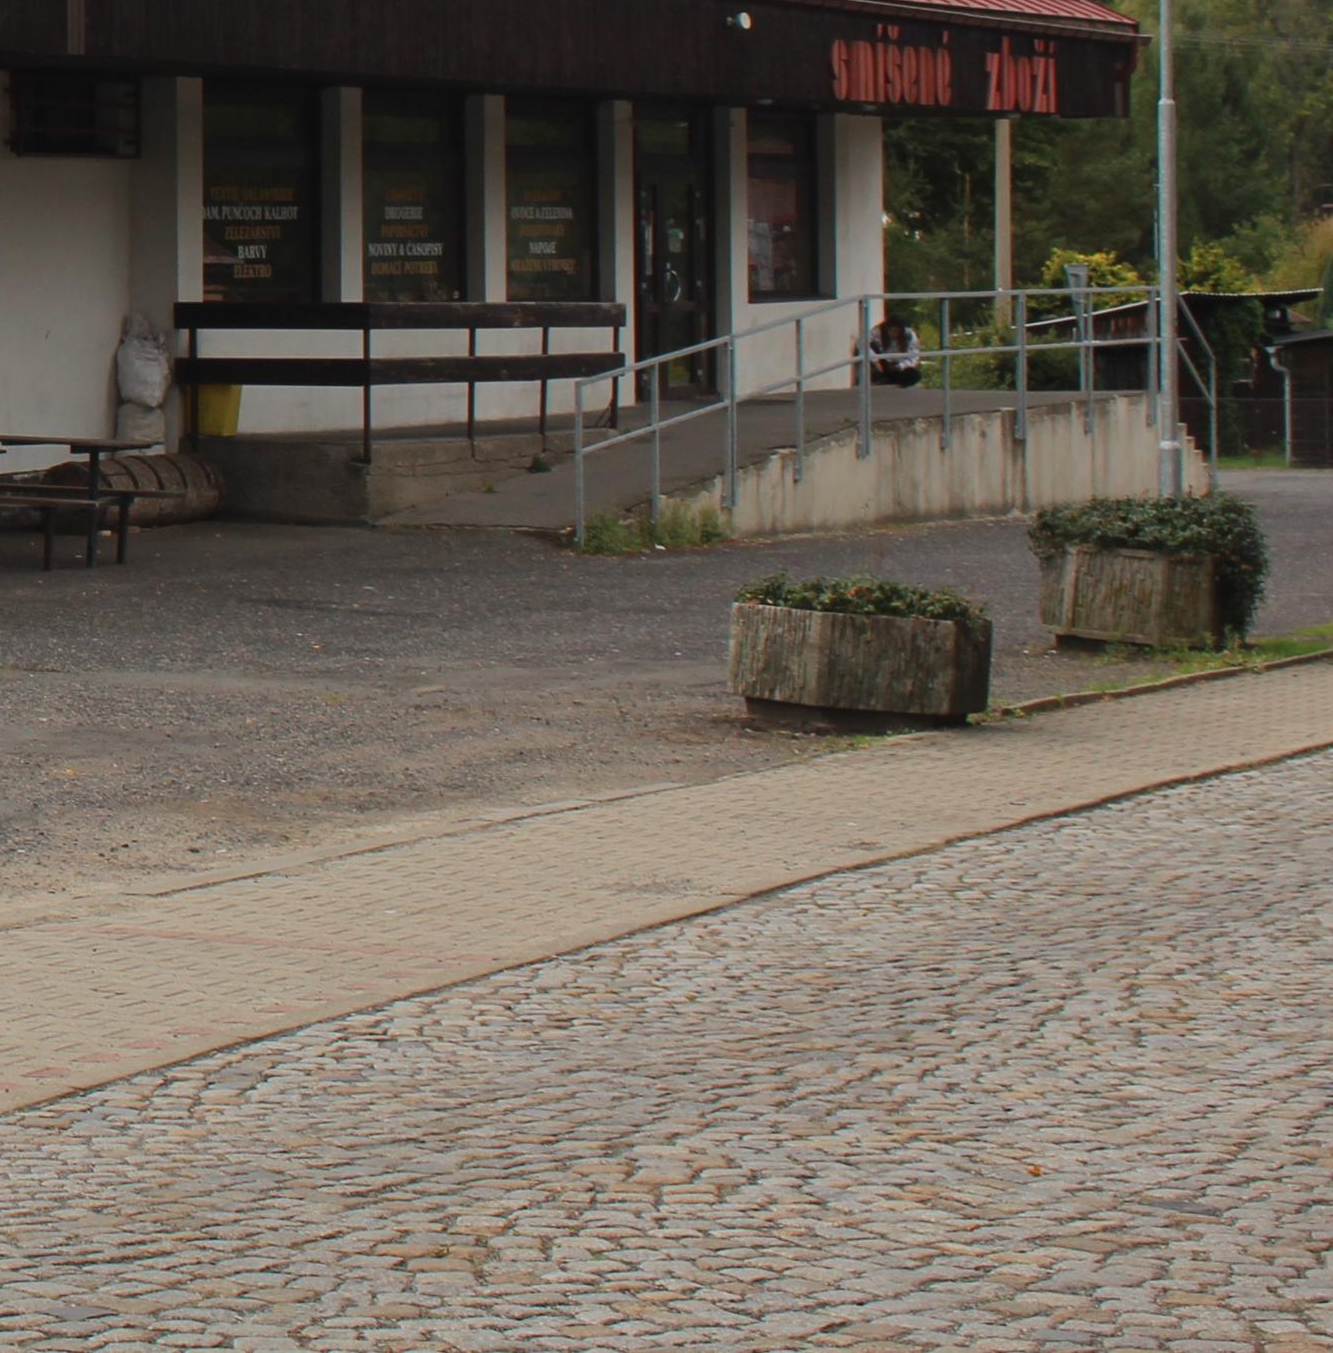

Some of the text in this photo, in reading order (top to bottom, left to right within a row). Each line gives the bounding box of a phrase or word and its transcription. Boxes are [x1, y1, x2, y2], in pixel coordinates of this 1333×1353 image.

[831, 23, 1057, 113] smíšené zboží
[384, 206, 423, 220] DROGERIE
[237, 245, 268, 260] BARVY
[368, 243, 397, 257] NOVINY
[406, 240, 445, 257] ČASOPISY
[233, 263, 273, 279] ELEKTRO
